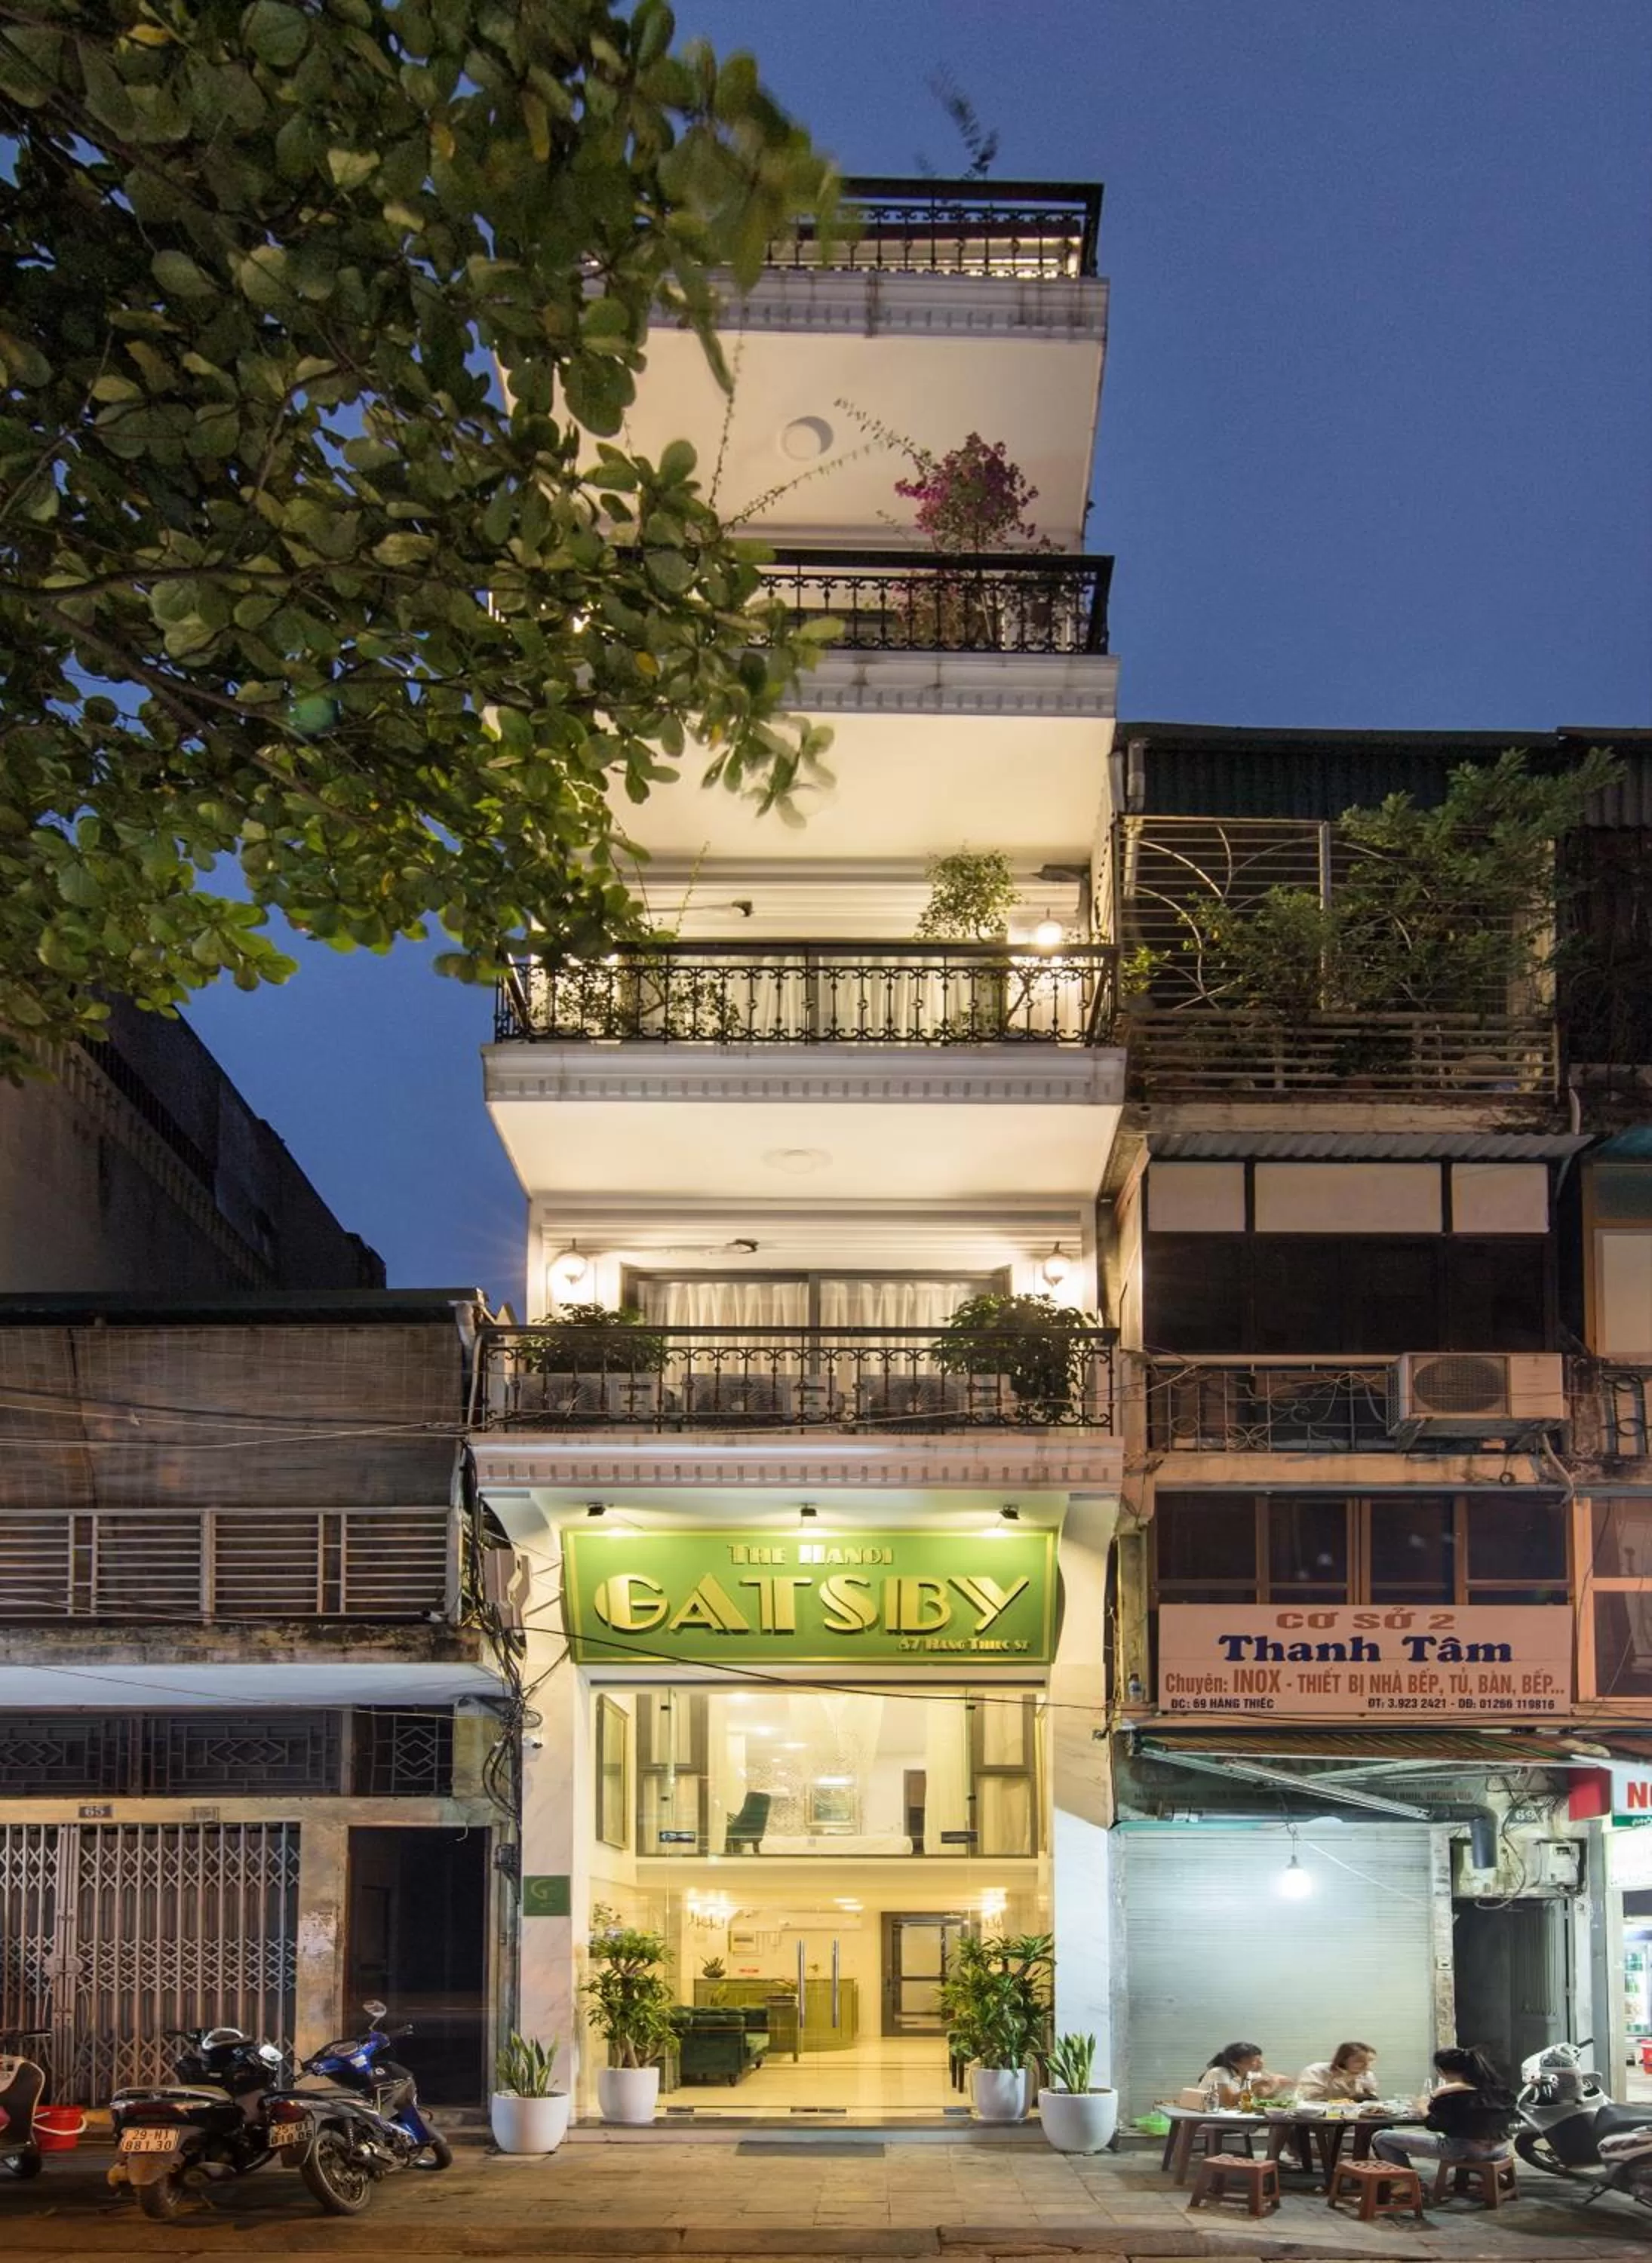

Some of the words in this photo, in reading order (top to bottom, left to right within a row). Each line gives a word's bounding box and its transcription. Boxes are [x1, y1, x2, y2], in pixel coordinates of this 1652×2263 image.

[594, 1572, 1030, 1635] GATSBY
[1276, 1611, 1340, 1629] CƠ
[1353, 1607, 1417, 1630] SỞ
[1427, 1614, 1456, 1630] 2
[1218, 1635, 1382, 1662] Thanh
[1401, 1635, 1514, 1663] Tâm
[1233, 1669, 1281, 1693] INOX
[1297, 1666, 1342, 1693] THIẾT
[1348, 1674, 1364, 1696] BỊ
[1193, 1698, 1207, 1709] 69
[1420, 1698, 1446, 1709] 2421
[1627, 1781, 1652, 1809] N
